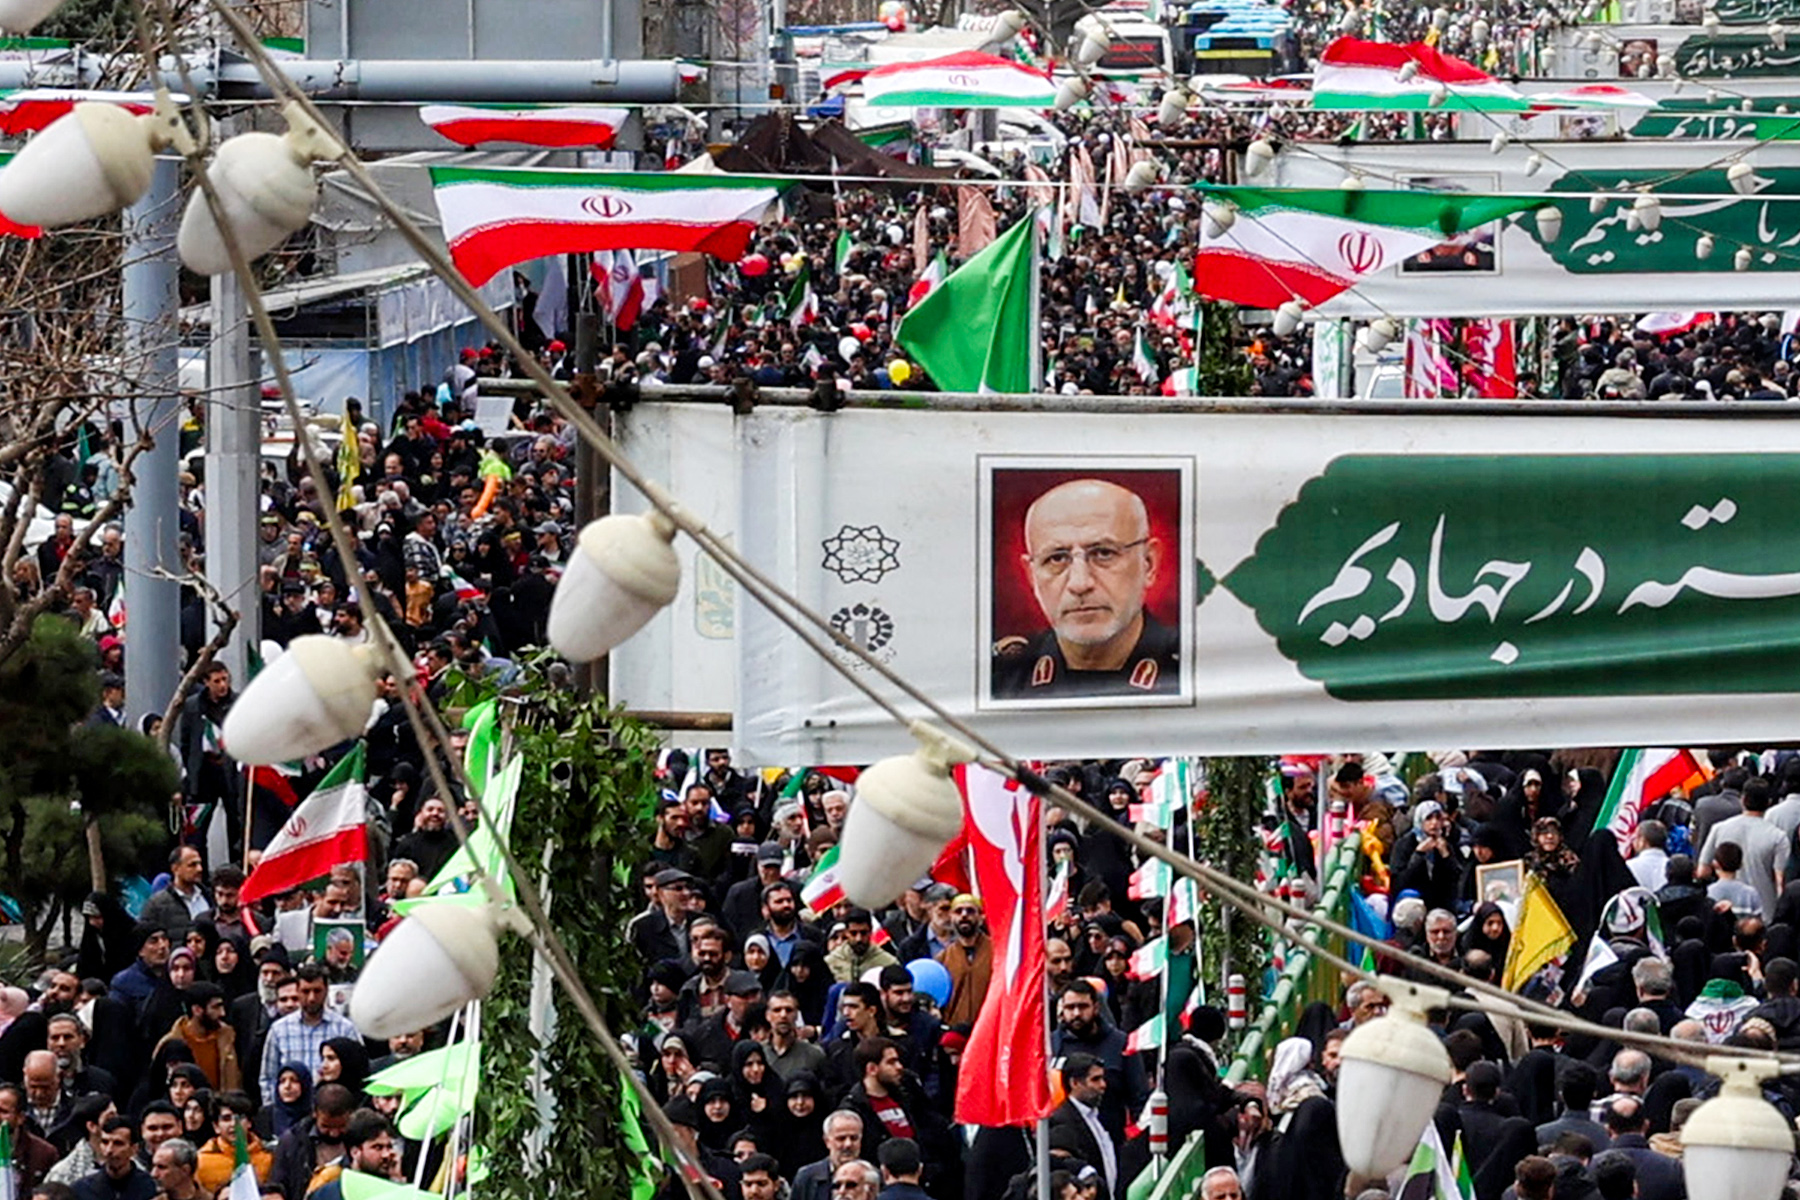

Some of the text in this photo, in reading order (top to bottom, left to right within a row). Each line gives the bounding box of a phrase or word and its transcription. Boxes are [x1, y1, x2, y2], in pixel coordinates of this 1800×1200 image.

[1758, 201, 1778, 264] با
[1297, 512, 1532, 666] جهادیم
[1525, 546, 1606, 624] در
